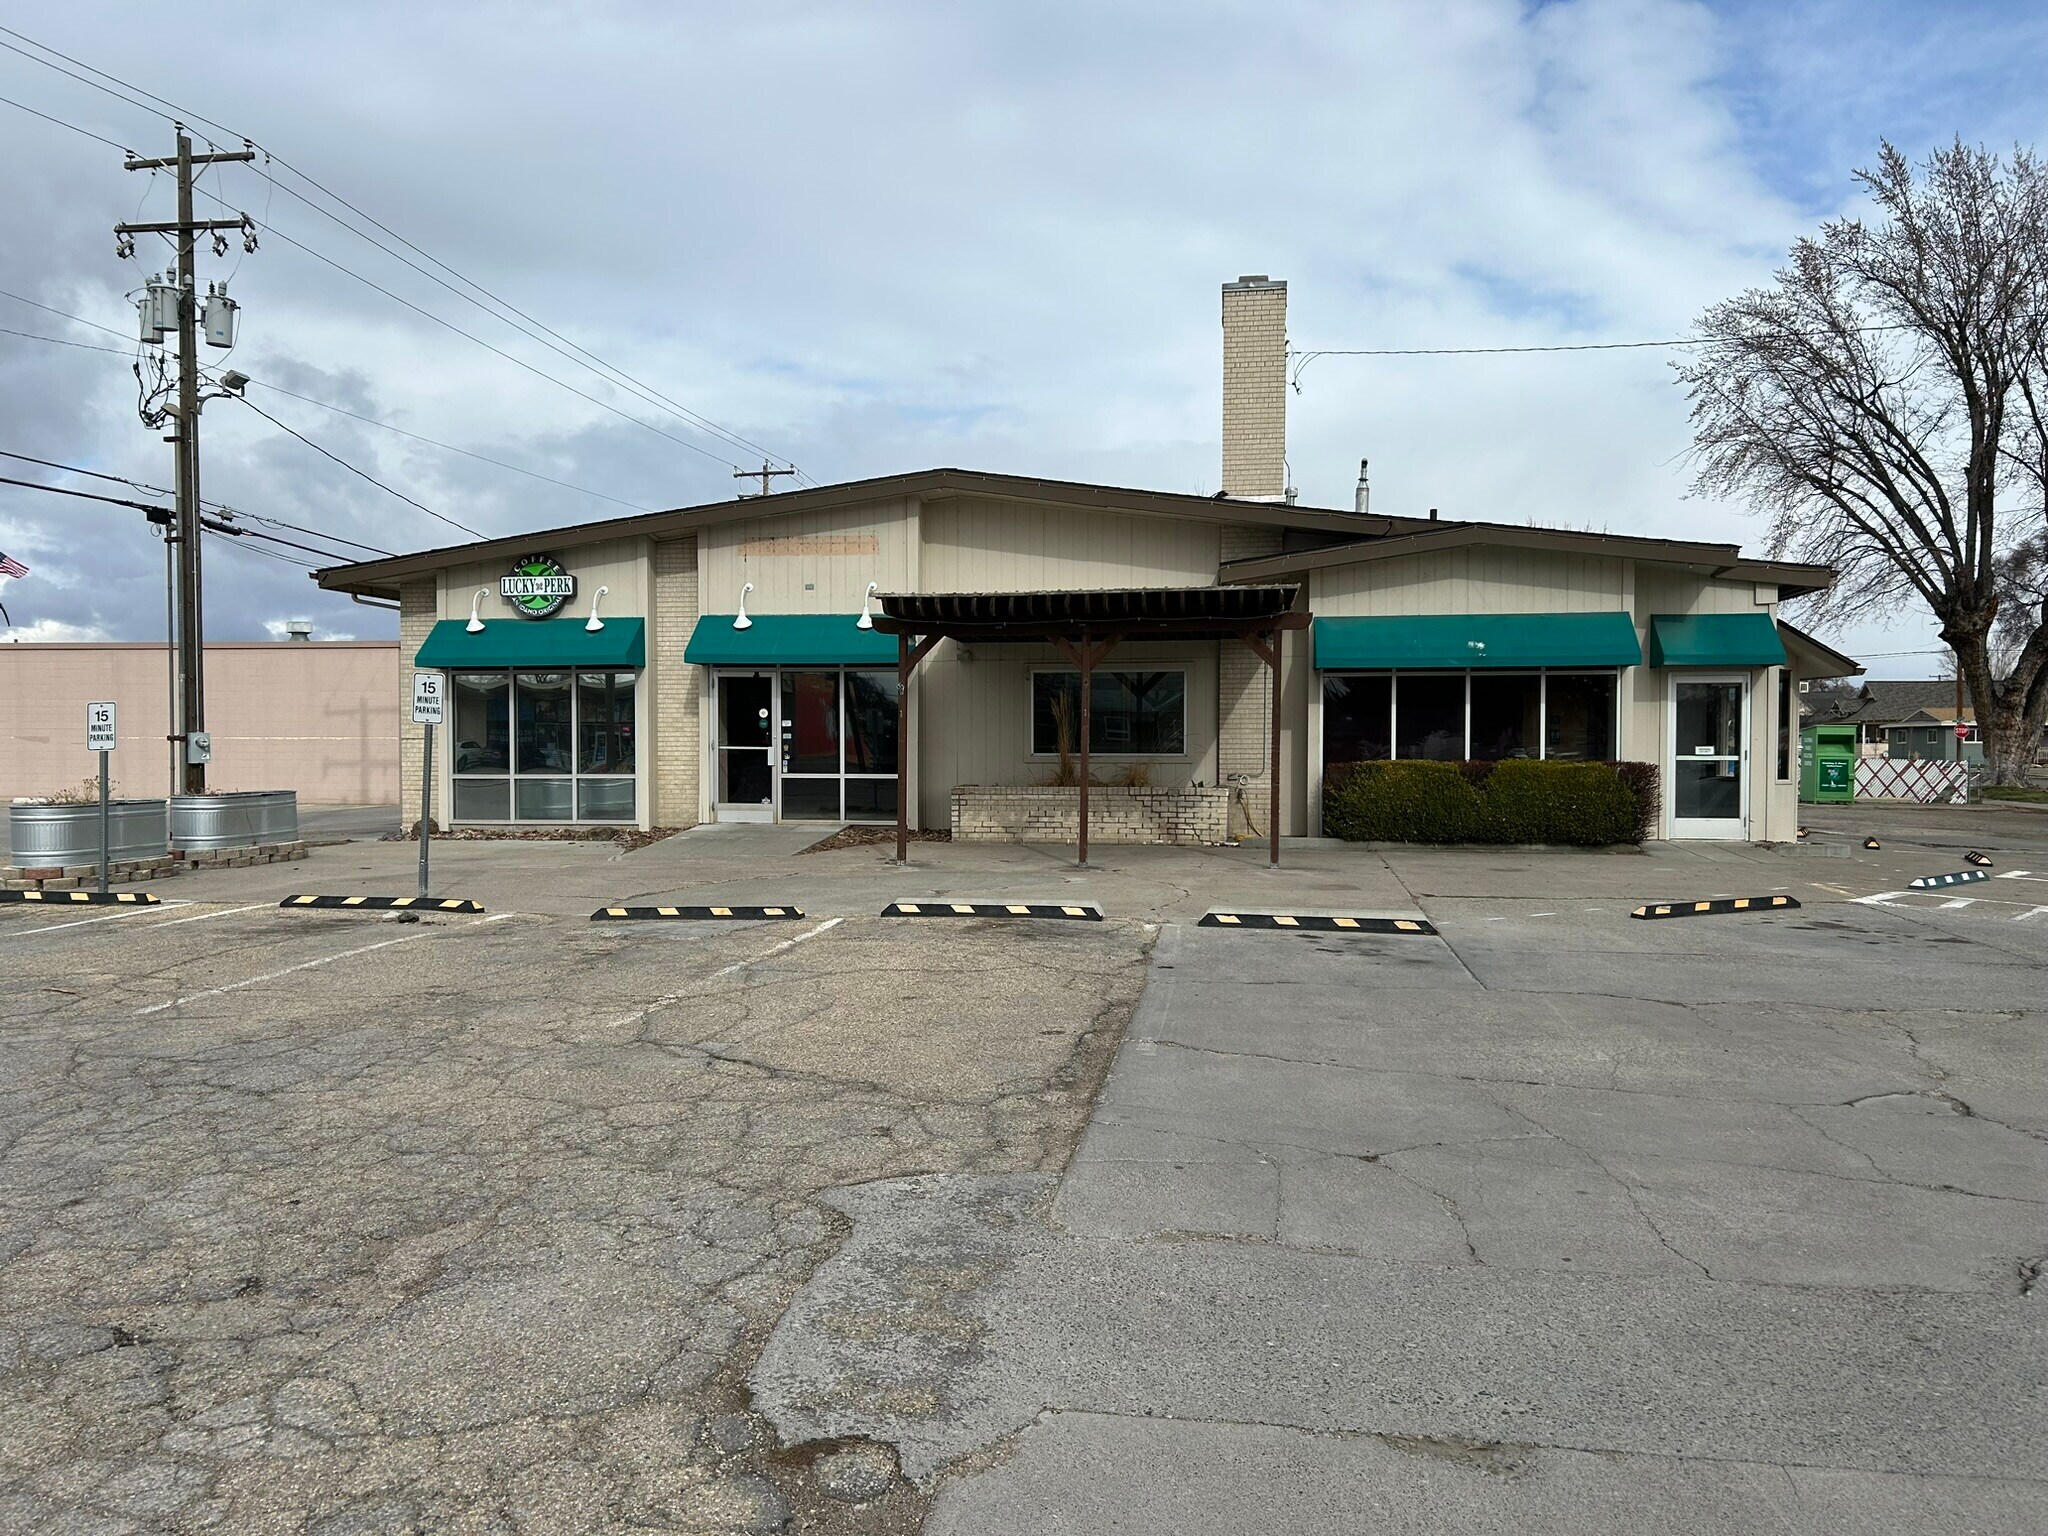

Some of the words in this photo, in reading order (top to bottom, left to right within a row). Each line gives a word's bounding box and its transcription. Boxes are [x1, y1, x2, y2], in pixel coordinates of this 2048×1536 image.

[513, 556, 561, 573] COFFEE
[502, 578, 536, 594] LUCKY
[543, 577, 571, 593] PERK
[421, 681, 436, 694] 15
[416, 696, 439, 705] MINUTE
[415, 705, 441, 715] PARKING
[95, 710, 109, 722] 15
[91, 724, 113, 732] MINUTE
[89, 733, 114, 742] PARKING
